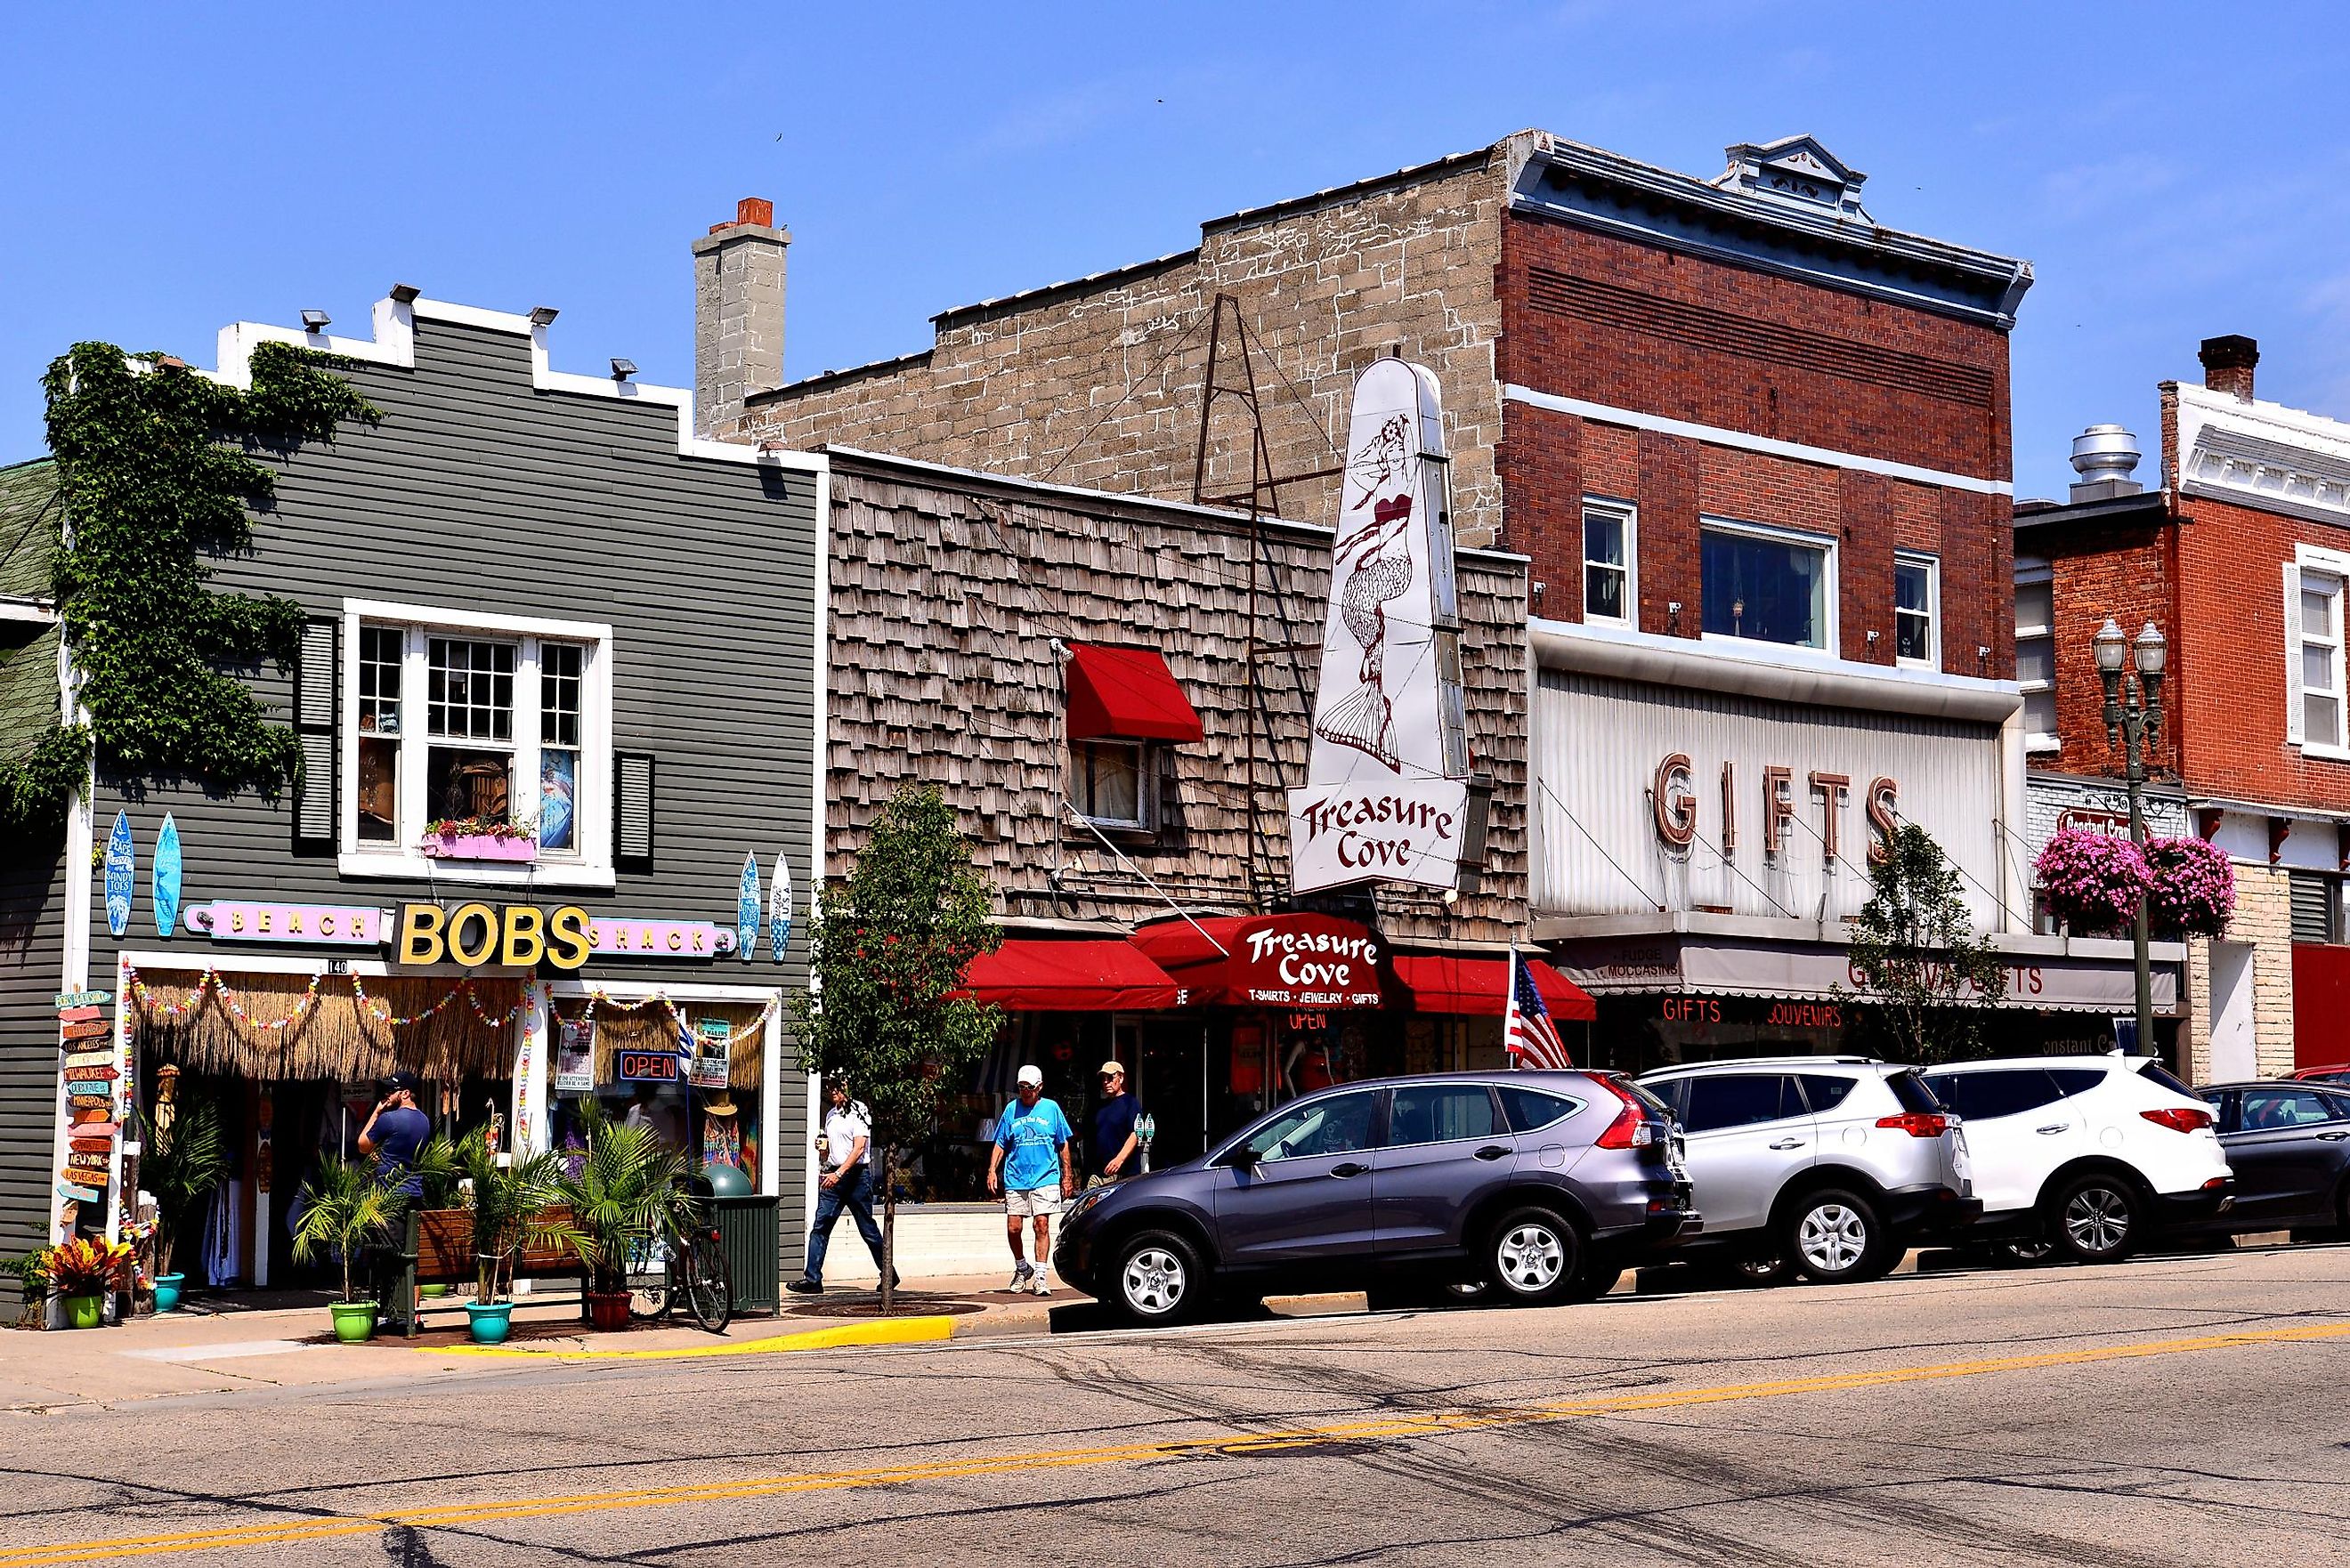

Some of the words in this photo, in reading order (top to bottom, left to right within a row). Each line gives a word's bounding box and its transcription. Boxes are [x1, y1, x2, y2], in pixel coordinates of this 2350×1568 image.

[1654, 752, 1901, 866] GIFTS
[1300, 796, 1453, 842] Treasure
[109, 837, 132, 856] PEACE
[1337, 830, 1410, 868] Cove
[106, 870, 133, 883] SANDY
[110, 881, 129, 891] TOES
[232, 909, 365, 938] BEACH
[397, 902, 591, 969] BOBS
[588, 925, 705, 952] SHACK
[1247, 928, 1377, 965] Treasure
[1621, 949, 1662, 961] FUDGE
[329, 961, 347, 974] 140
[1279, 954, 1349, 985] Cove
[1608, 963, 1678, 977] MOCCASINS
[1249, 990, 1290, 1002] T-SHIRTS
[1300, 992, 1342, 1004] JEWELRY
[1352, 994, 1379, 1005] GIFTS
[1290, 1014, 1326, 1029] OPEN
[1663, 999, 1721, 1022] GIFTS
[1767, 1003, 1842, 1027] SOUVENIRS
[65, 1042, 77, 1052] LOS
[77, 1039, 100, 1051] ANGELES
[2043, 1038, 2093, 1055] onstant
[65, 1067, 105, 1079] MILWAUKEE
[624, 1056, 675, 1079] OPEN
[70, 1153, 85, 1165] NEW
[86, 1154, 103, 1166] YORK
[66, 1170, 77, 1180] LAS
[77, 1171, 99, 1183] VEGAS
